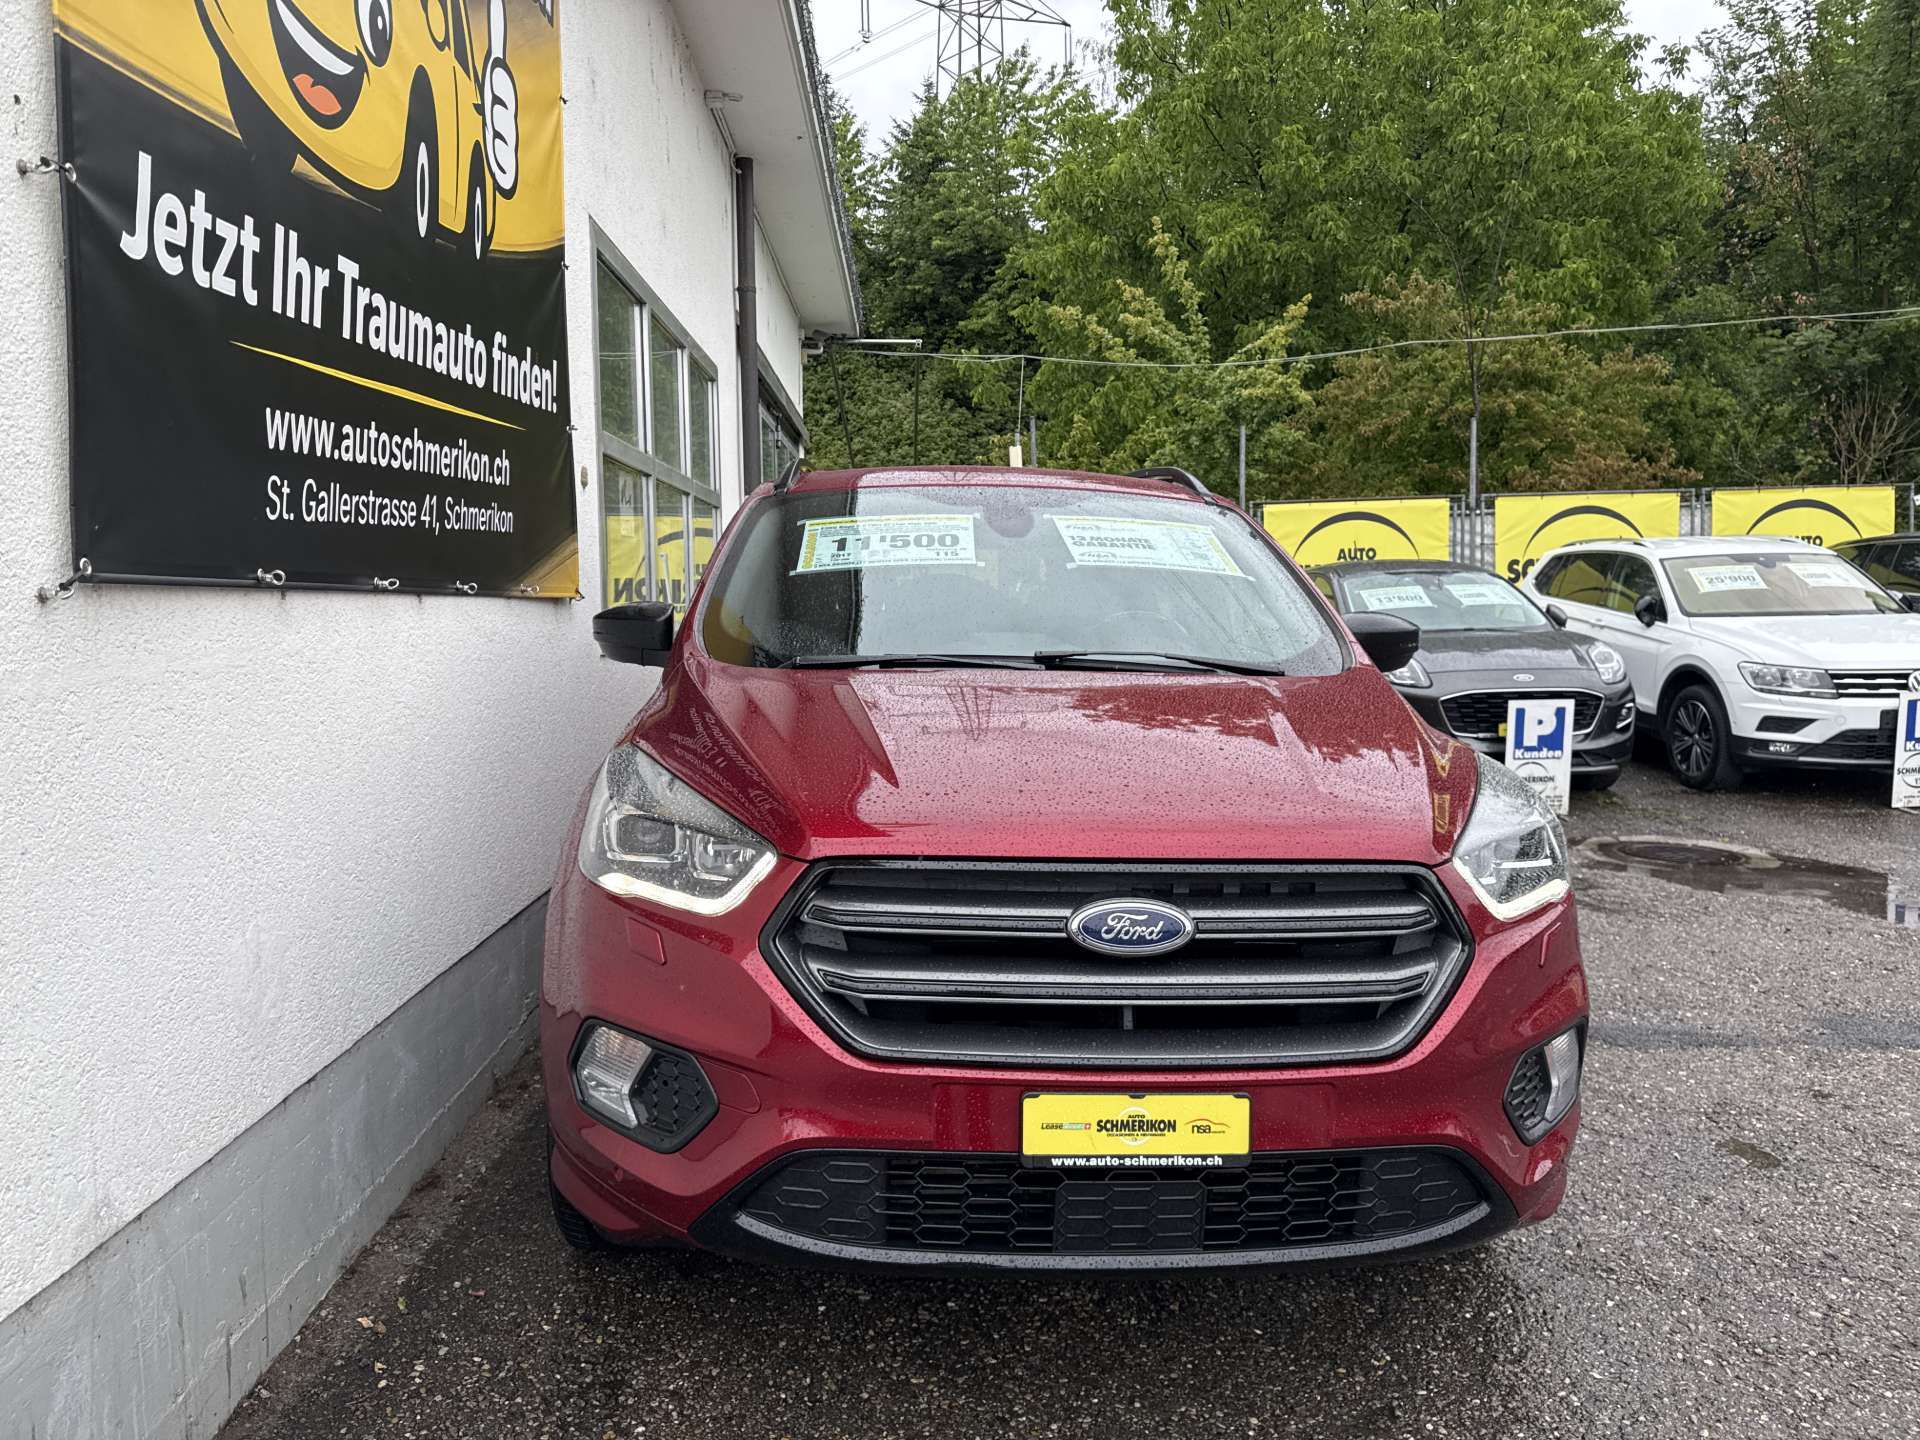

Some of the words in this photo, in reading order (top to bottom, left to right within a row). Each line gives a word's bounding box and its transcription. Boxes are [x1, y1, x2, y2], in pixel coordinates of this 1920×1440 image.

[120, 150, 260, 306] Jetzt
[272, 222, 330, 329] Ihr
[338, 254, 487, 388] Traumauto
[492, 331, 557, 413] finden!
[265, 407, 510, 486] www.autoschmerikon.ch
[265, 475, 294, 520] St.
[302, 478, 417, 527] Gallerstrasse
[420, 494, 440, 536] 41,
[444, 496, 513, 533] Schmerikon
[831, 533, 960, 552] 11'500
[1072, 541, 1157, 550] GARANTIE
[1336, 547, 1376, 561] AUTO
[1522, 704, 1557, 747] P
[1514, 747, 1562, 759] Kunden
[1101, 912, 1164, 940] Ford
[1096, 1119, 1177, 1133] SCHMERIKON
[1191, 1124, 1212, 1134] nsa
[1051, 1155, 1223, 1166] www.auto-schmerikon.ch
